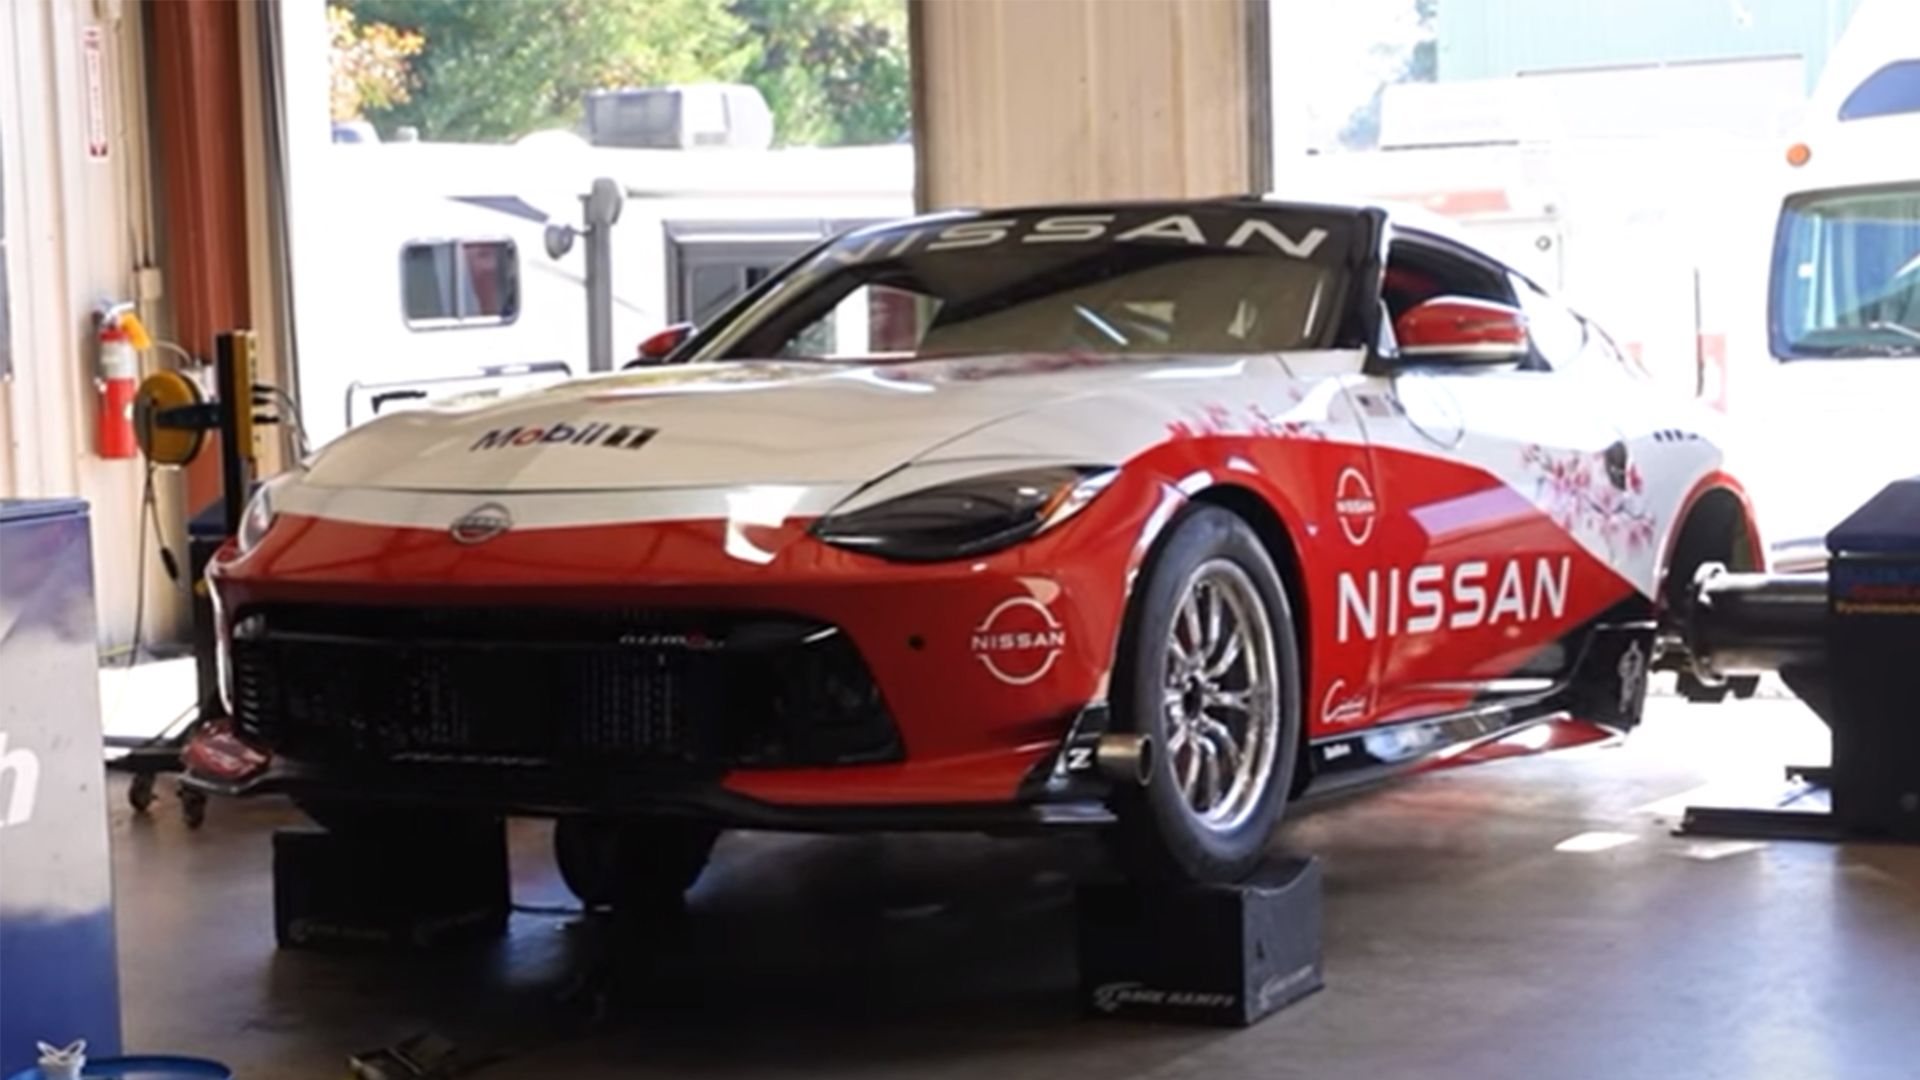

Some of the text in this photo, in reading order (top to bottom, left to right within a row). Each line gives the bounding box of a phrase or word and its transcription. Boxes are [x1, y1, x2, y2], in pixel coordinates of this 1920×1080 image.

[469, 422, 611, 451] Mobil
[1336, 555, 1571, 643] NISSAN
[971, 632, 1065, 650] NISSAN
[1069, 747, 1092, 769] Z
